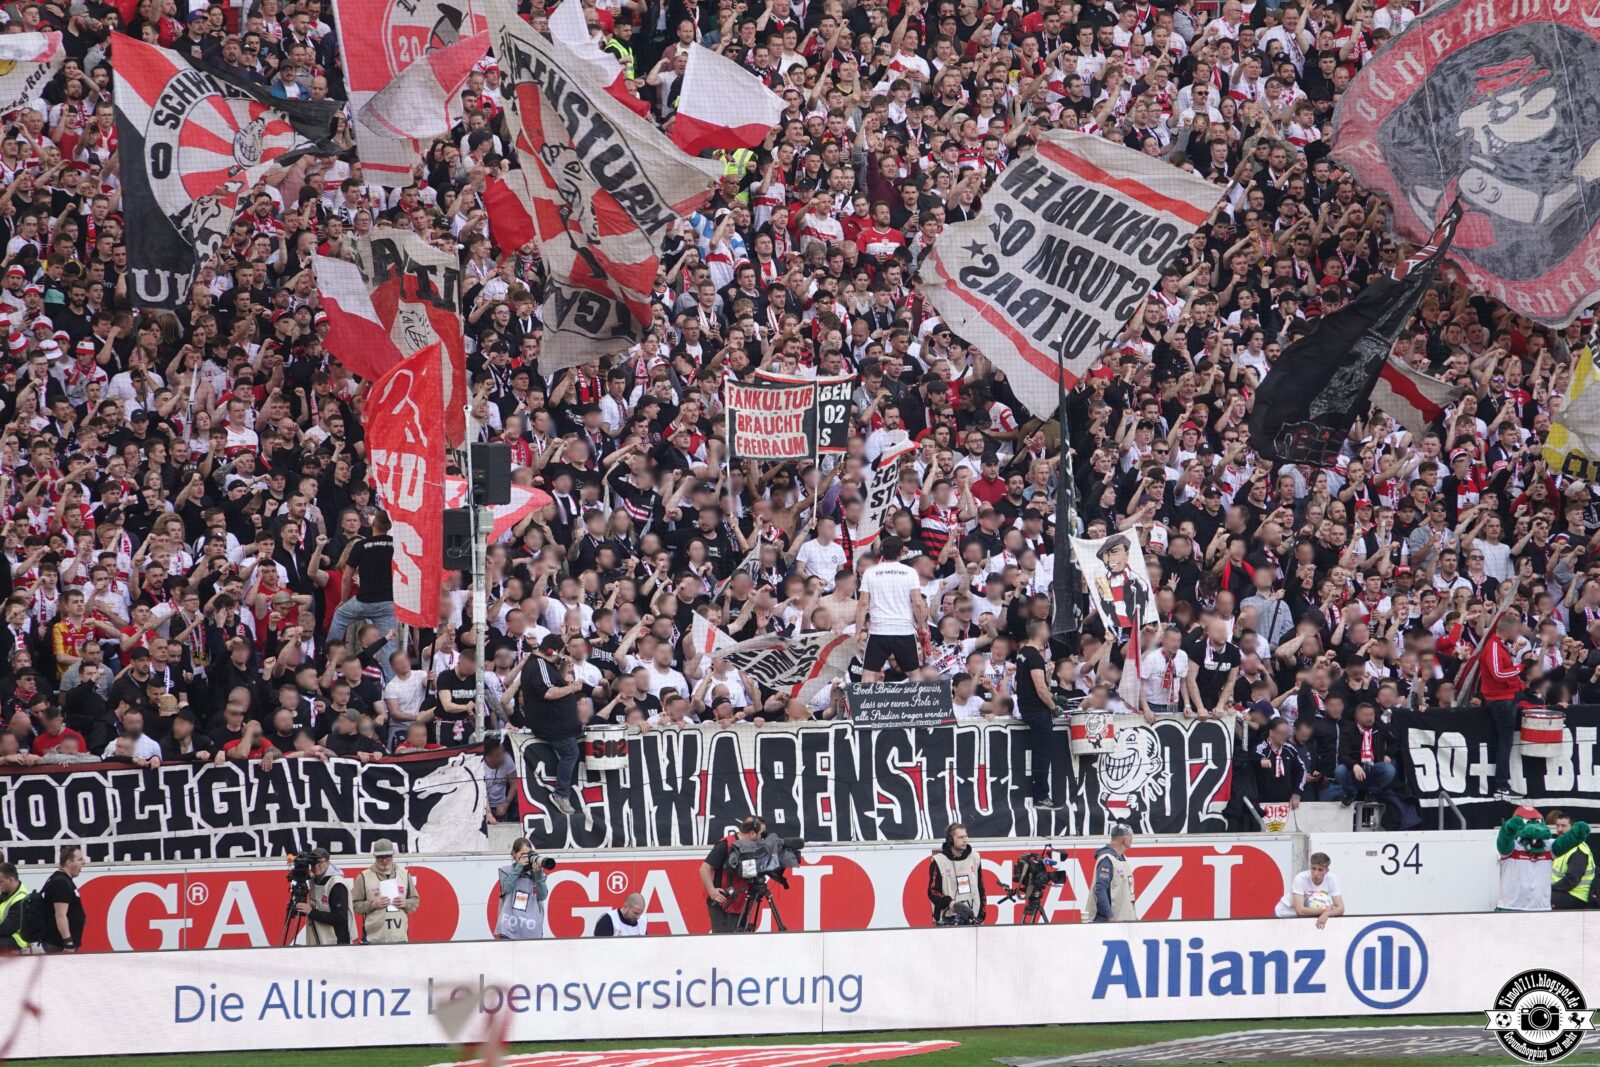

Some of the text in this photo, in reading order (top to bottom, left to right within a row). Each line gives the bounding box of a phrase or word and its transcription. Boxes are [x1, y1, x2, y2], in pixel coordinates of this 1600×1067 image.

[728, 387, 813, 411] FANKULTUR
[819, 382, 852, 402] BEN
[737, 413, 802, 436] BRAUCHT
[824, 405, 846, 424] 02
[736, 436, 806, 456] FREIRAUM
[853, 683, 873, 695] Doch
[904, 682, 917, 693] seid
[860, 699, 875, 709] dass
[877, 700, 889, 708] wir
[855, 711, 868, 721] alle
[871, 709, 900, 720] Stadien
[901, 711, 923, 722] tragen
[1380, 843, 1423, 875] 34
[385, 919, 402, 930] TV
[501, 914, 536, 930] FOTO
[1092, 938, 1326, 999] Allianz
[174, 984, 244, 1023] Die
[259, 978, 412, 1021] Allianz
